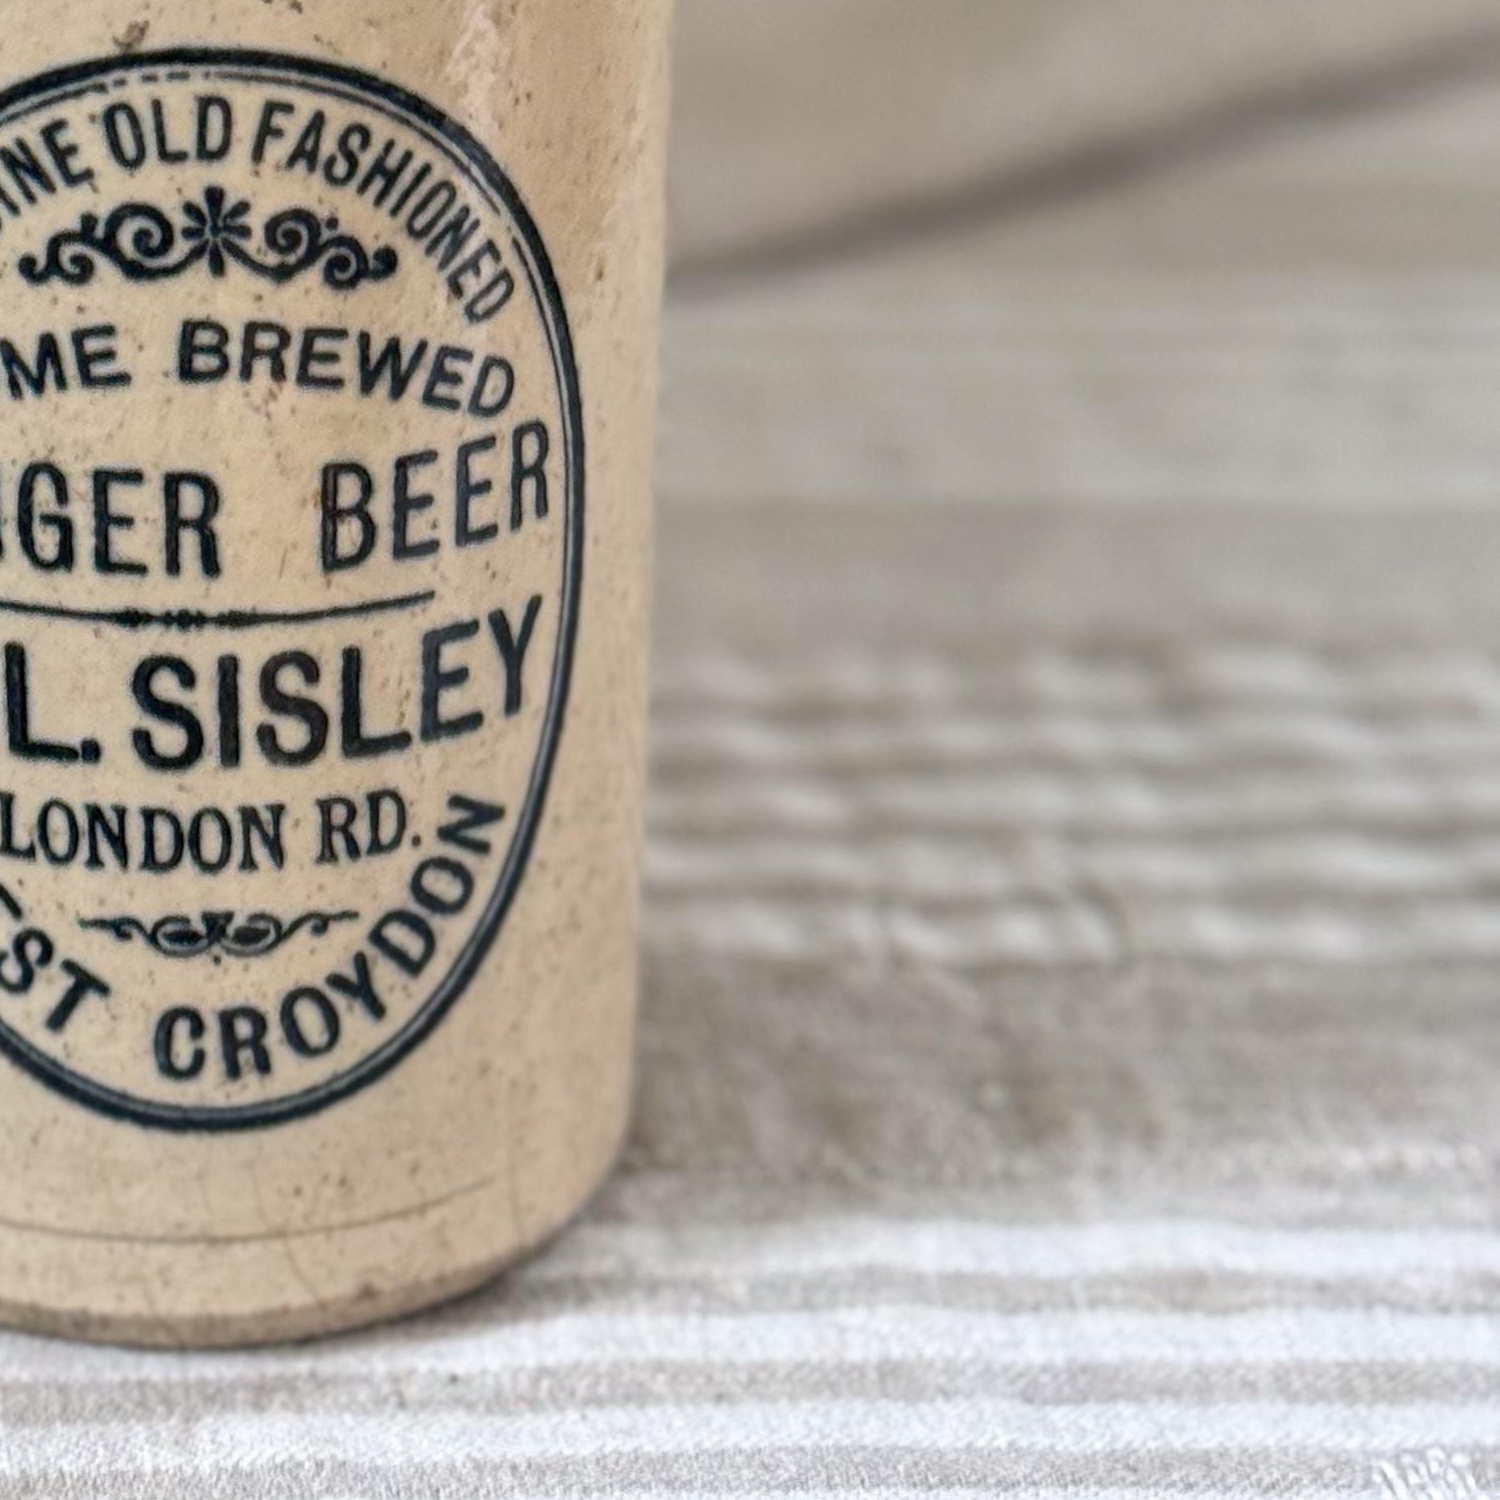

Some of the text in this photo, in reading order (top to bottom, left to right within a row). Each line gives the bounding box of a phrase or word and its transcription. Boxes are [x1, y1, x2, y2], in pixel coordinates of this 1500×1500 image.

[102, 94, 233, 171] OLD
[251, 100, 516, 325] FASHIONED
[174, 316, 516, 419] BREWED
[316, 417, 550, 579] BEER
[1, 639, 104, 766] L.
[129, 593, 543, 773] SISLEY
[314, 788, 422, 865] RD.
[152, 793, 507, 1082] CROYDON
